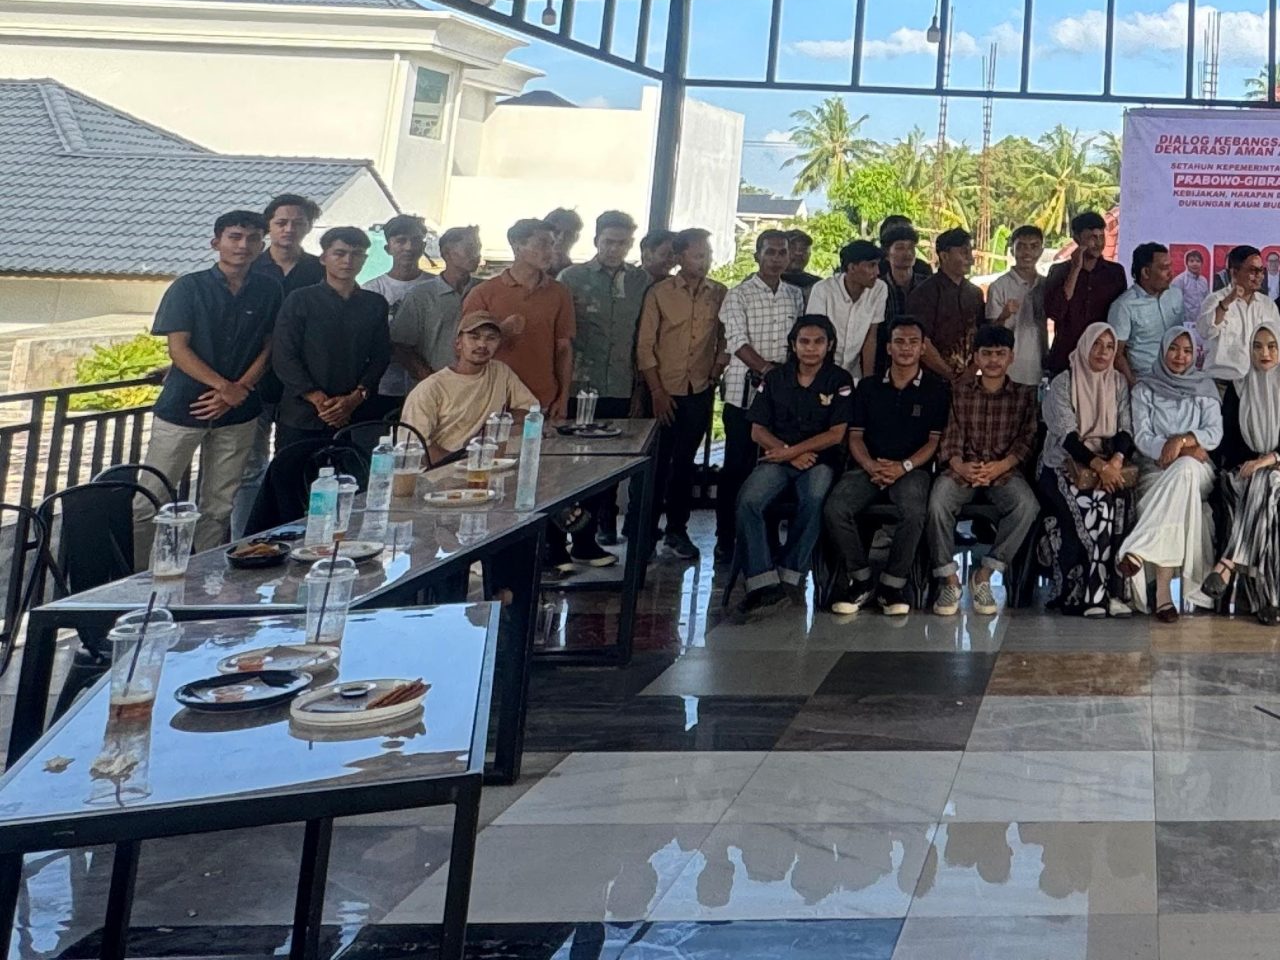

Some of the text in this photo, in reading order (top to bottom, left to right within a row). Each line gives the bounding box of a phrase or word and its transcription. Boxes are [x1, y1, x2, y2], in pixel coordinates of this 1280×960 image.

[1159, 134, 1210, 145] DIALOG
[1155, 144, 1231, 155] DEKLARASI
[1234, 146, 1275, 156] AMAN
[1173, 190, 1228, 198] KEBIJAKAN,
[1231, 191, 1274, 199] HARAPAN
[1179, 200, 1231, 208] DUKUNGAN
